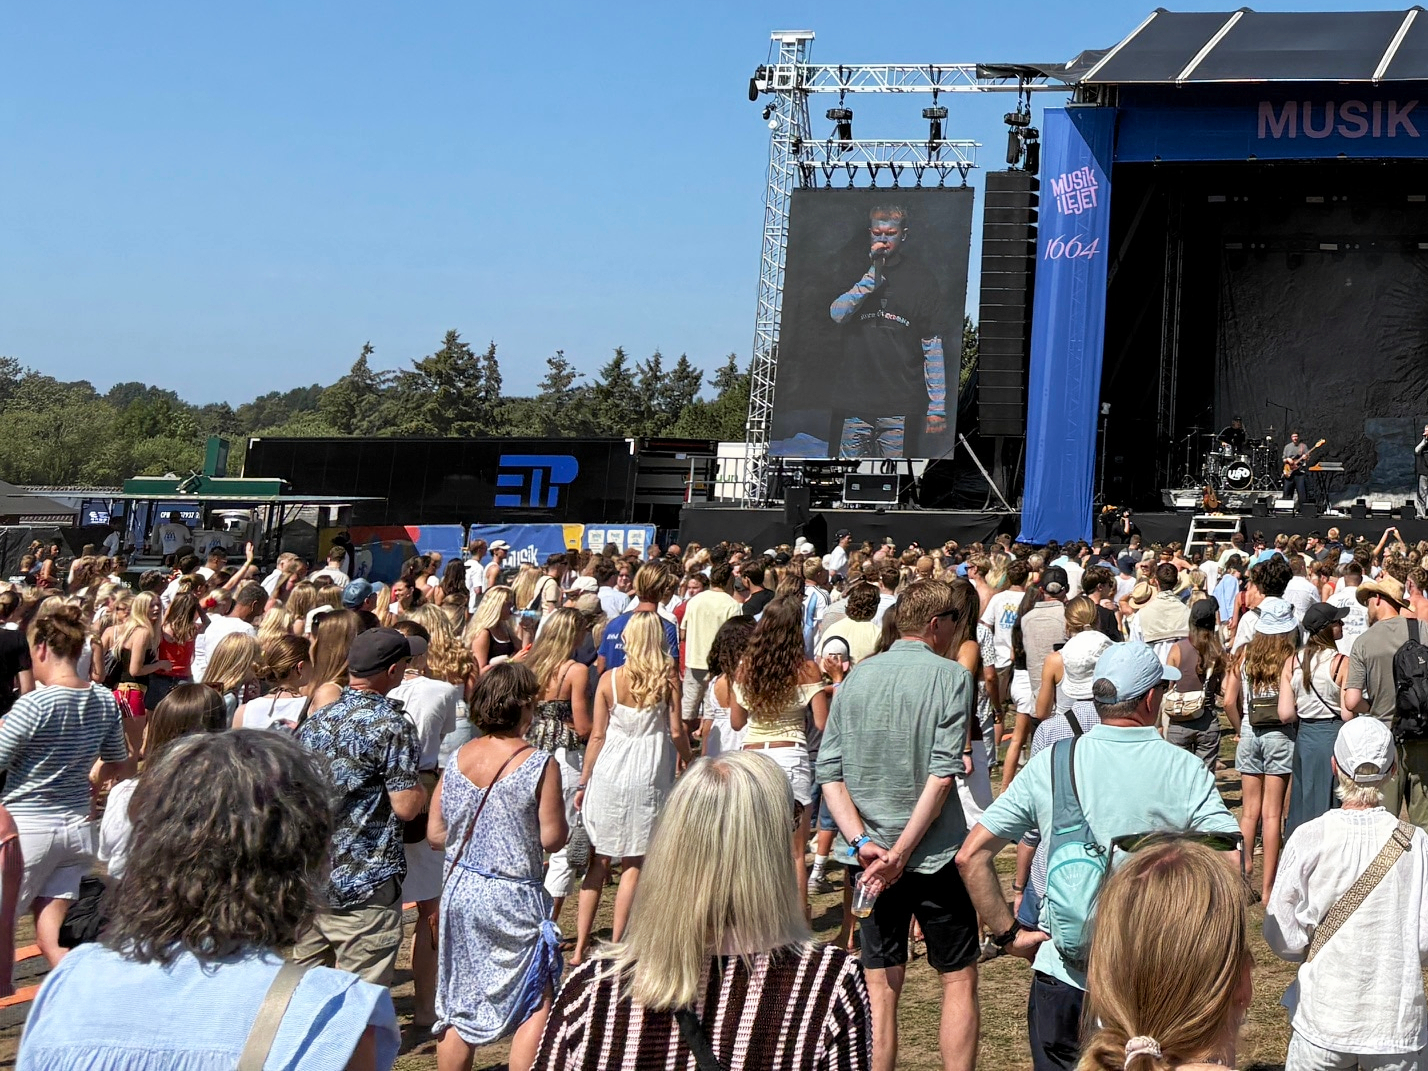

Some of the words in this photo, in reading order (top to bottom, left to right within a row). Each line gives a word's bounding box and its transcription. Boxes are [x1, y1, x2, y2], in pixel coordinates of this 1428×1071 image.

[1257, 100, 1421, 139] MUSIK
[1061, 185, 1099, 215] LEJET
[1044, 234, 1100, 260] 1664
